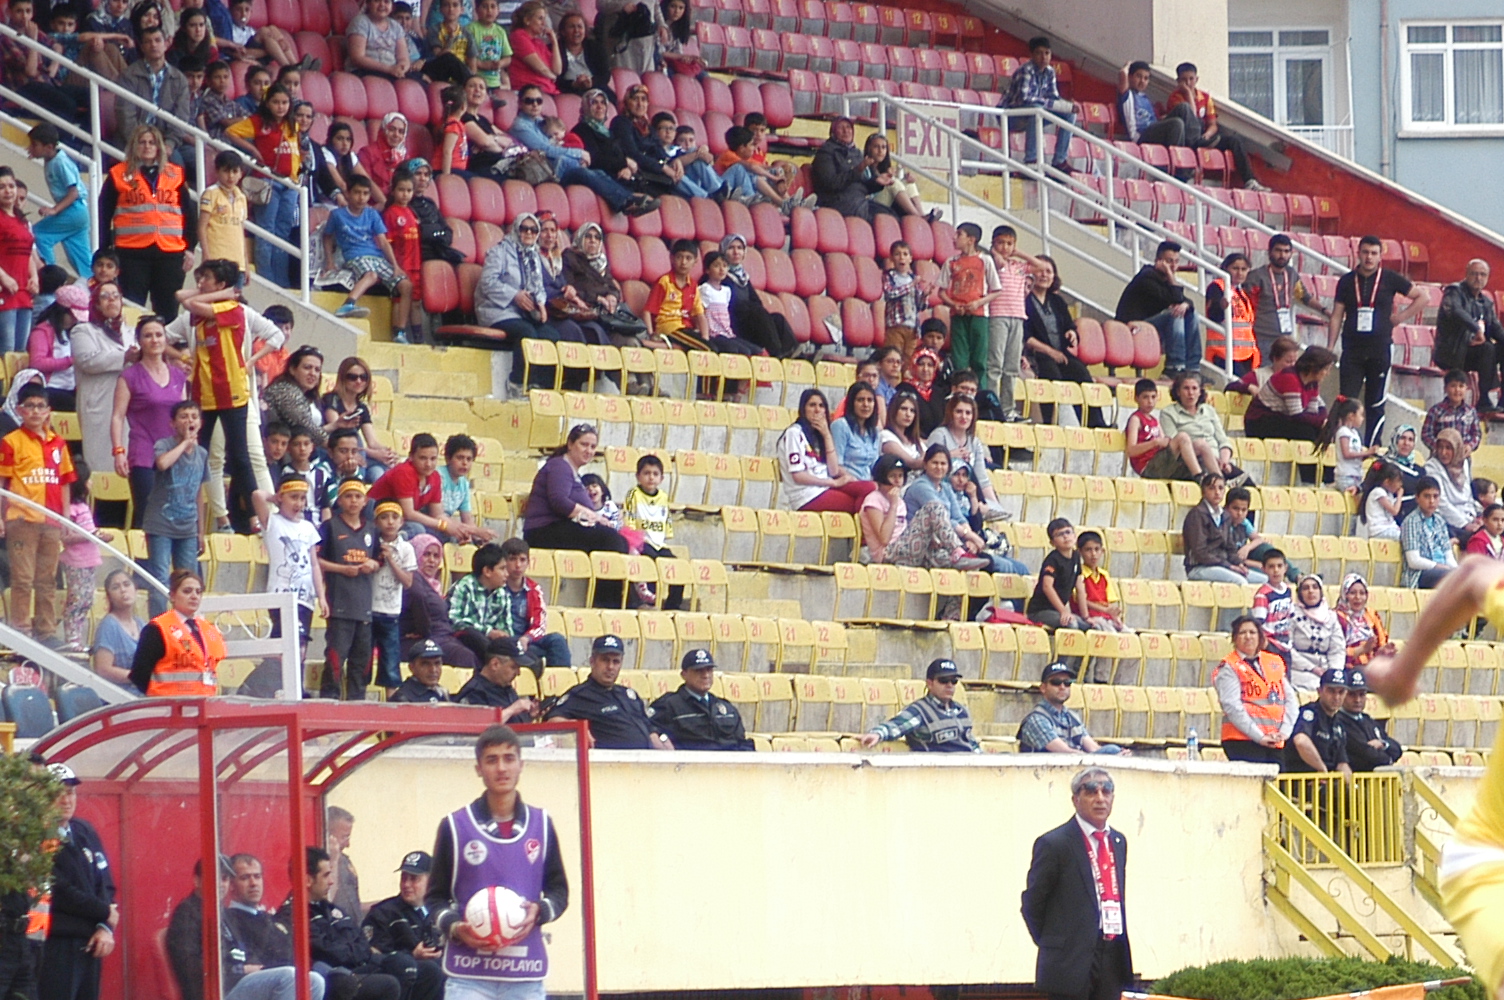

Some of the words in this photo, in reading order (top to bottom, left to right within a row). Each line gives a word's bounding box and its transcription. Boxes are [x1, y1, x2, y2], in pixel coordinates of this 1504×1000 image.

[904, 113, 959, 157] EXIT
[31, 467, 56, 477] TÜRK
[453, 955, 481, 968] TOP
[483, 957, 543, 973] TOPLAYICI
